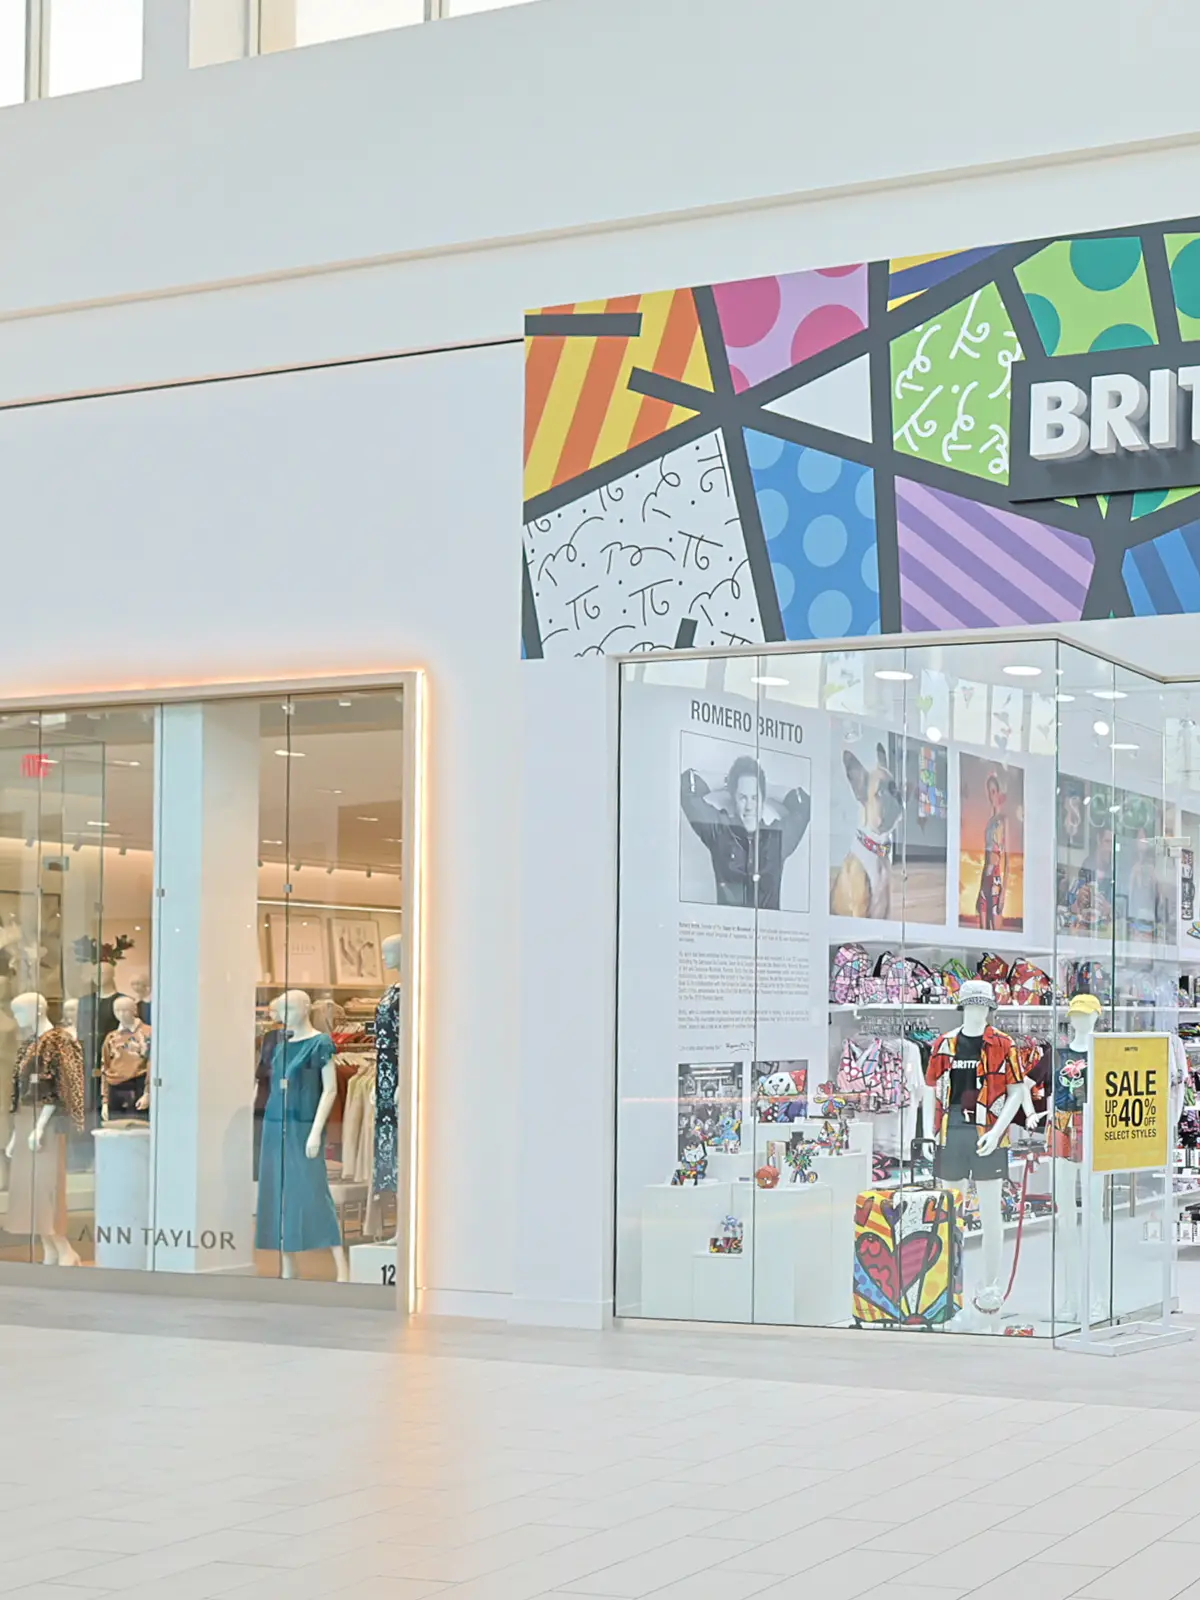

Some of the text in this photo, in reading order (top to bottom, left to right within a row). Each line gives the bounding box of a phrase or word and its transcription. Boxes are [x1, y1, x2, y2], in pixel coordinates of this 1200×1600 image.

[691, 700, 803, 744] ROMERO BRITTO
[1105, 1070, 1157, 1097] SALE
[1105, 1100, 1118, 1114] UP
[1106, 1115, 1118, 1128] TO
[1144, 1117, 1156, 1126] OFF
[1104, 1129, 1157, 1140] SELECT STYLES
[78, 1226, 236, 1250] ANN TAYLOR
